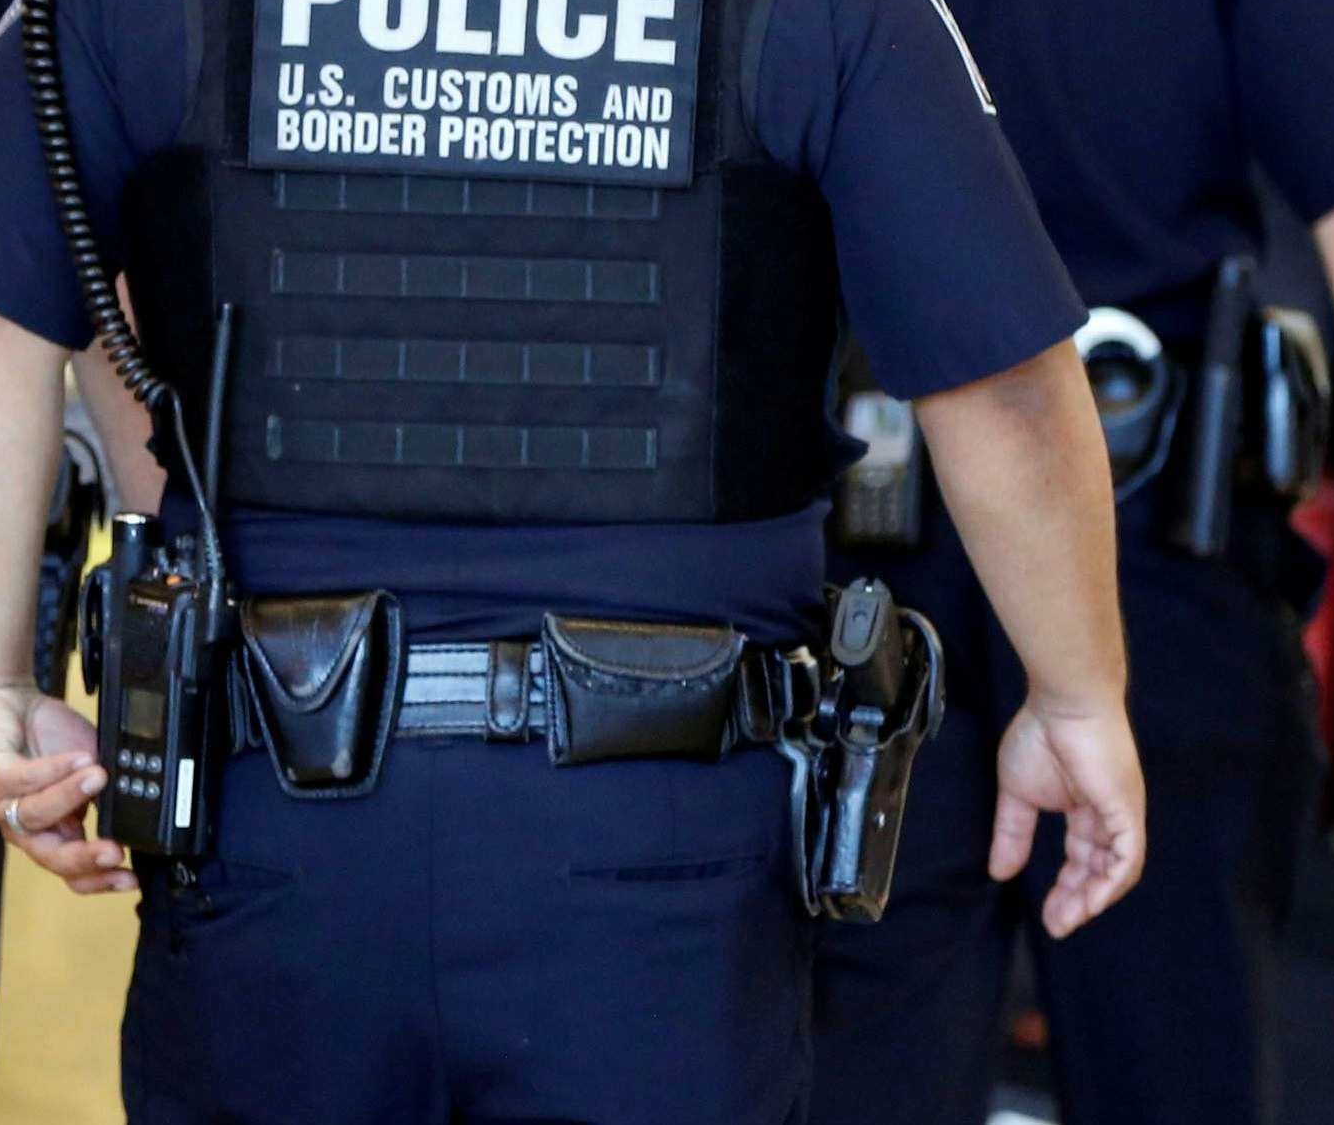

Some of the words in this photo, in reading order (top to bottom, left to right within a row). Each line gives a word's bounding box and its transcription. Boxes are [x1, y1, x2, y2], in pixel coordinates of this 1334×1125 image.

[277, 63, 355, 107] U.S.
[383, 66, 578, 117] CUSTOMS
[603, 84, 673, 123] AND
[277, 109, 425, 156] BORDER
[439, 116, 671, 170] PROTECTION
